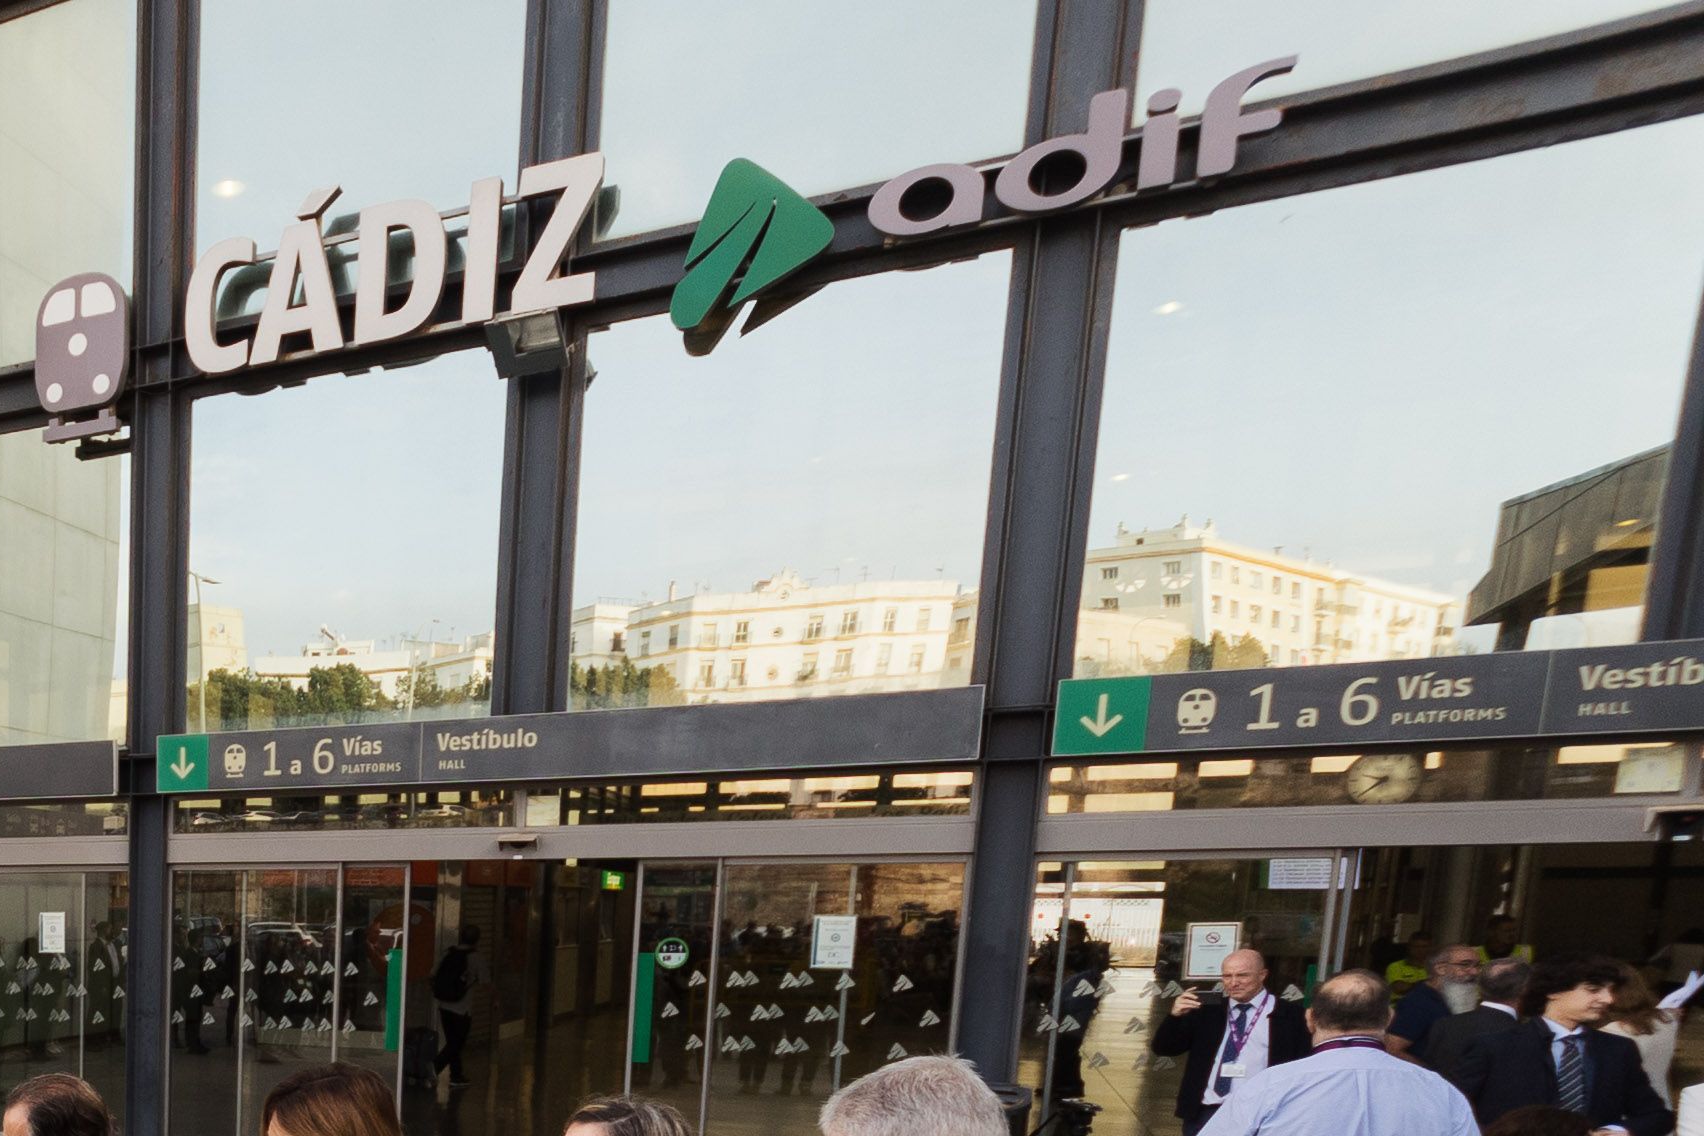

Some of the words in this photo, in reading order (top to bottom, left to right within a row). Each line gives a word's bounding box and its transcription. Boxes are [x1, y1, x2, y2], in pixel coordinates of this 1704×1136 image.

[868, 54, 1300, 235] adif
[184, 152, 605, 374] CÁDIZ
[1246, 683, 1281, 731] 1
[1296, 707, 1319, 728] a
[1340, 677, 1380, 726] 6
[1397, 671, 1475, 700] Vías
[1577, 701, 1633, 717] HALL
[1391, 706, 1508, 725] PLATFORMS
[437, 728, 538, 752] Vestíbulo
[263, 741, 282, 776] 1
[290, 759, 302, 775] a
[312, 738, 335, 774] 6
[343, 735, 383, 756] Vías
[438, 760, 466, 771] HALL
[341, 762, 402, 774] PLATFORMS
